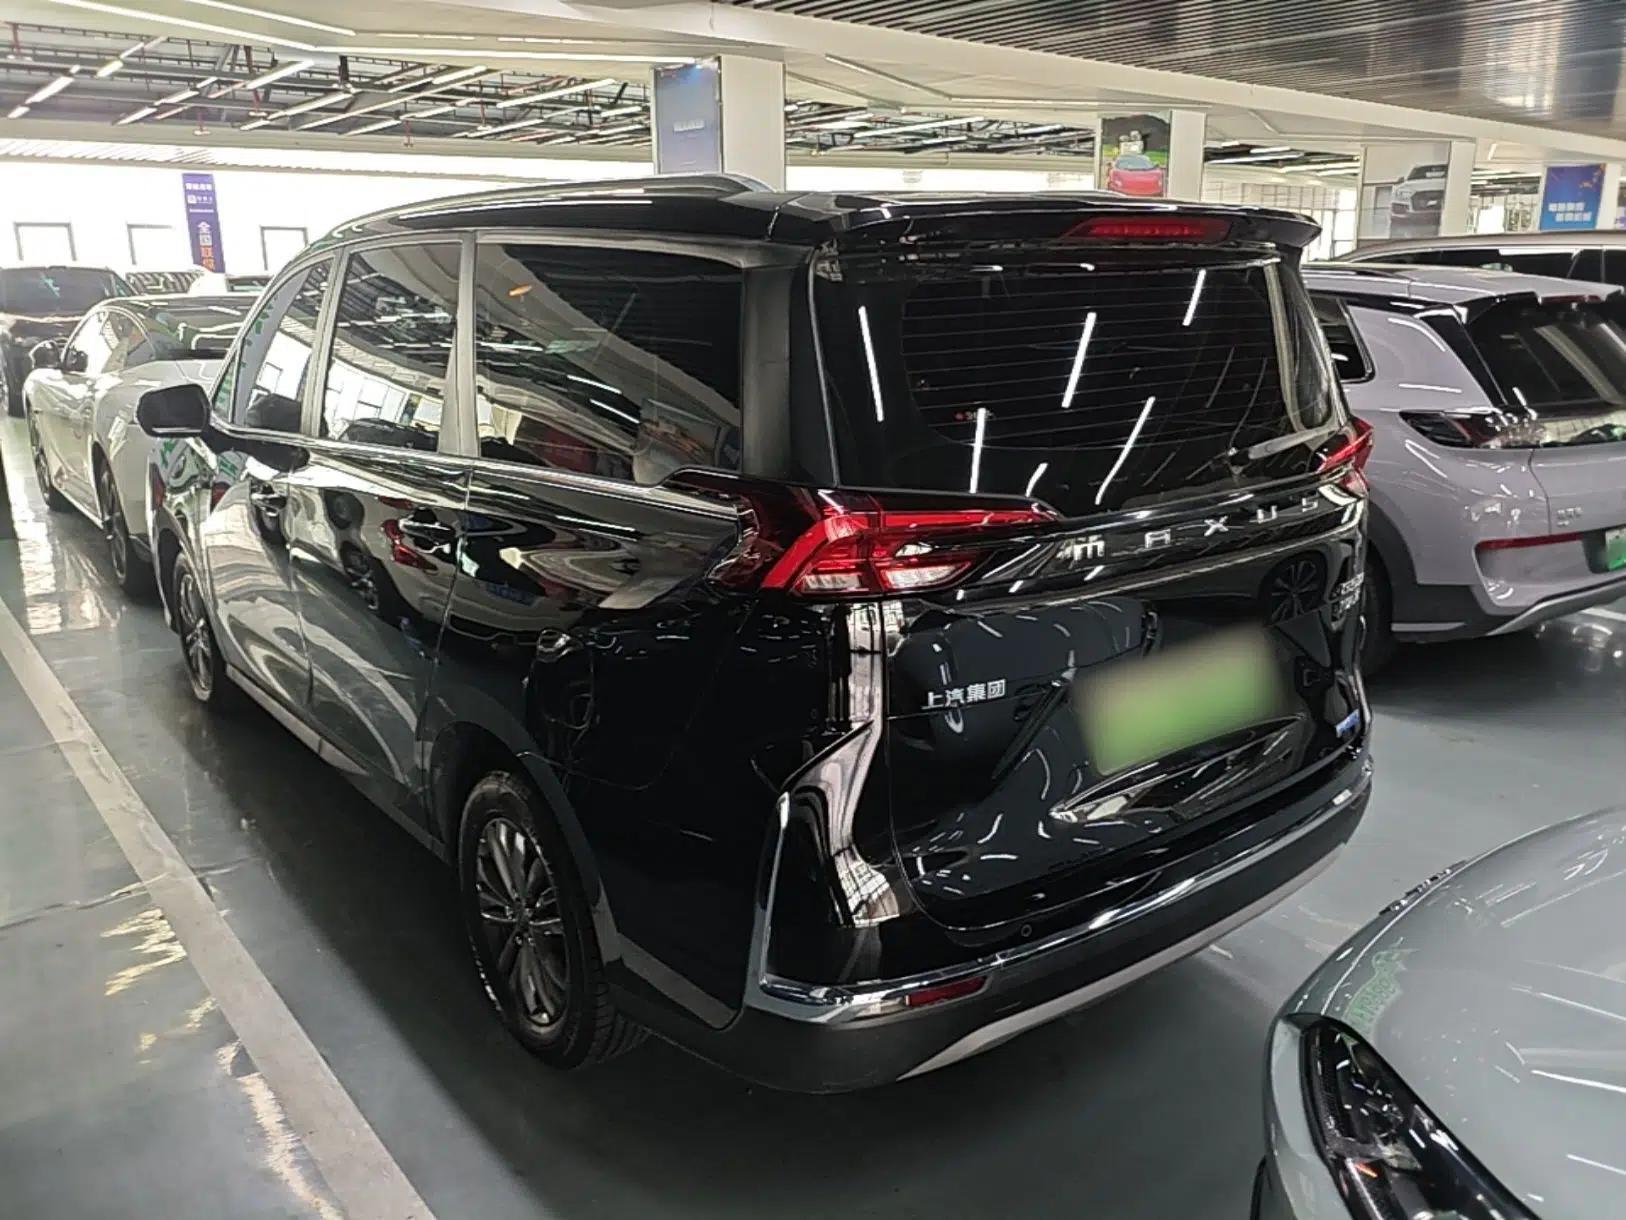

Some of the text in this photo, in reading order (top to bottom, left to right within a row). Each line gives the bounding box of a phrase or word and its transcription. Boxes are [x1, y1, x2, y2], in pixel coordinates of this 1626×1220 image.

[1072, 495, 1319, 562] MAXUS
[921, 679, 1006, 709] 上汽集团
